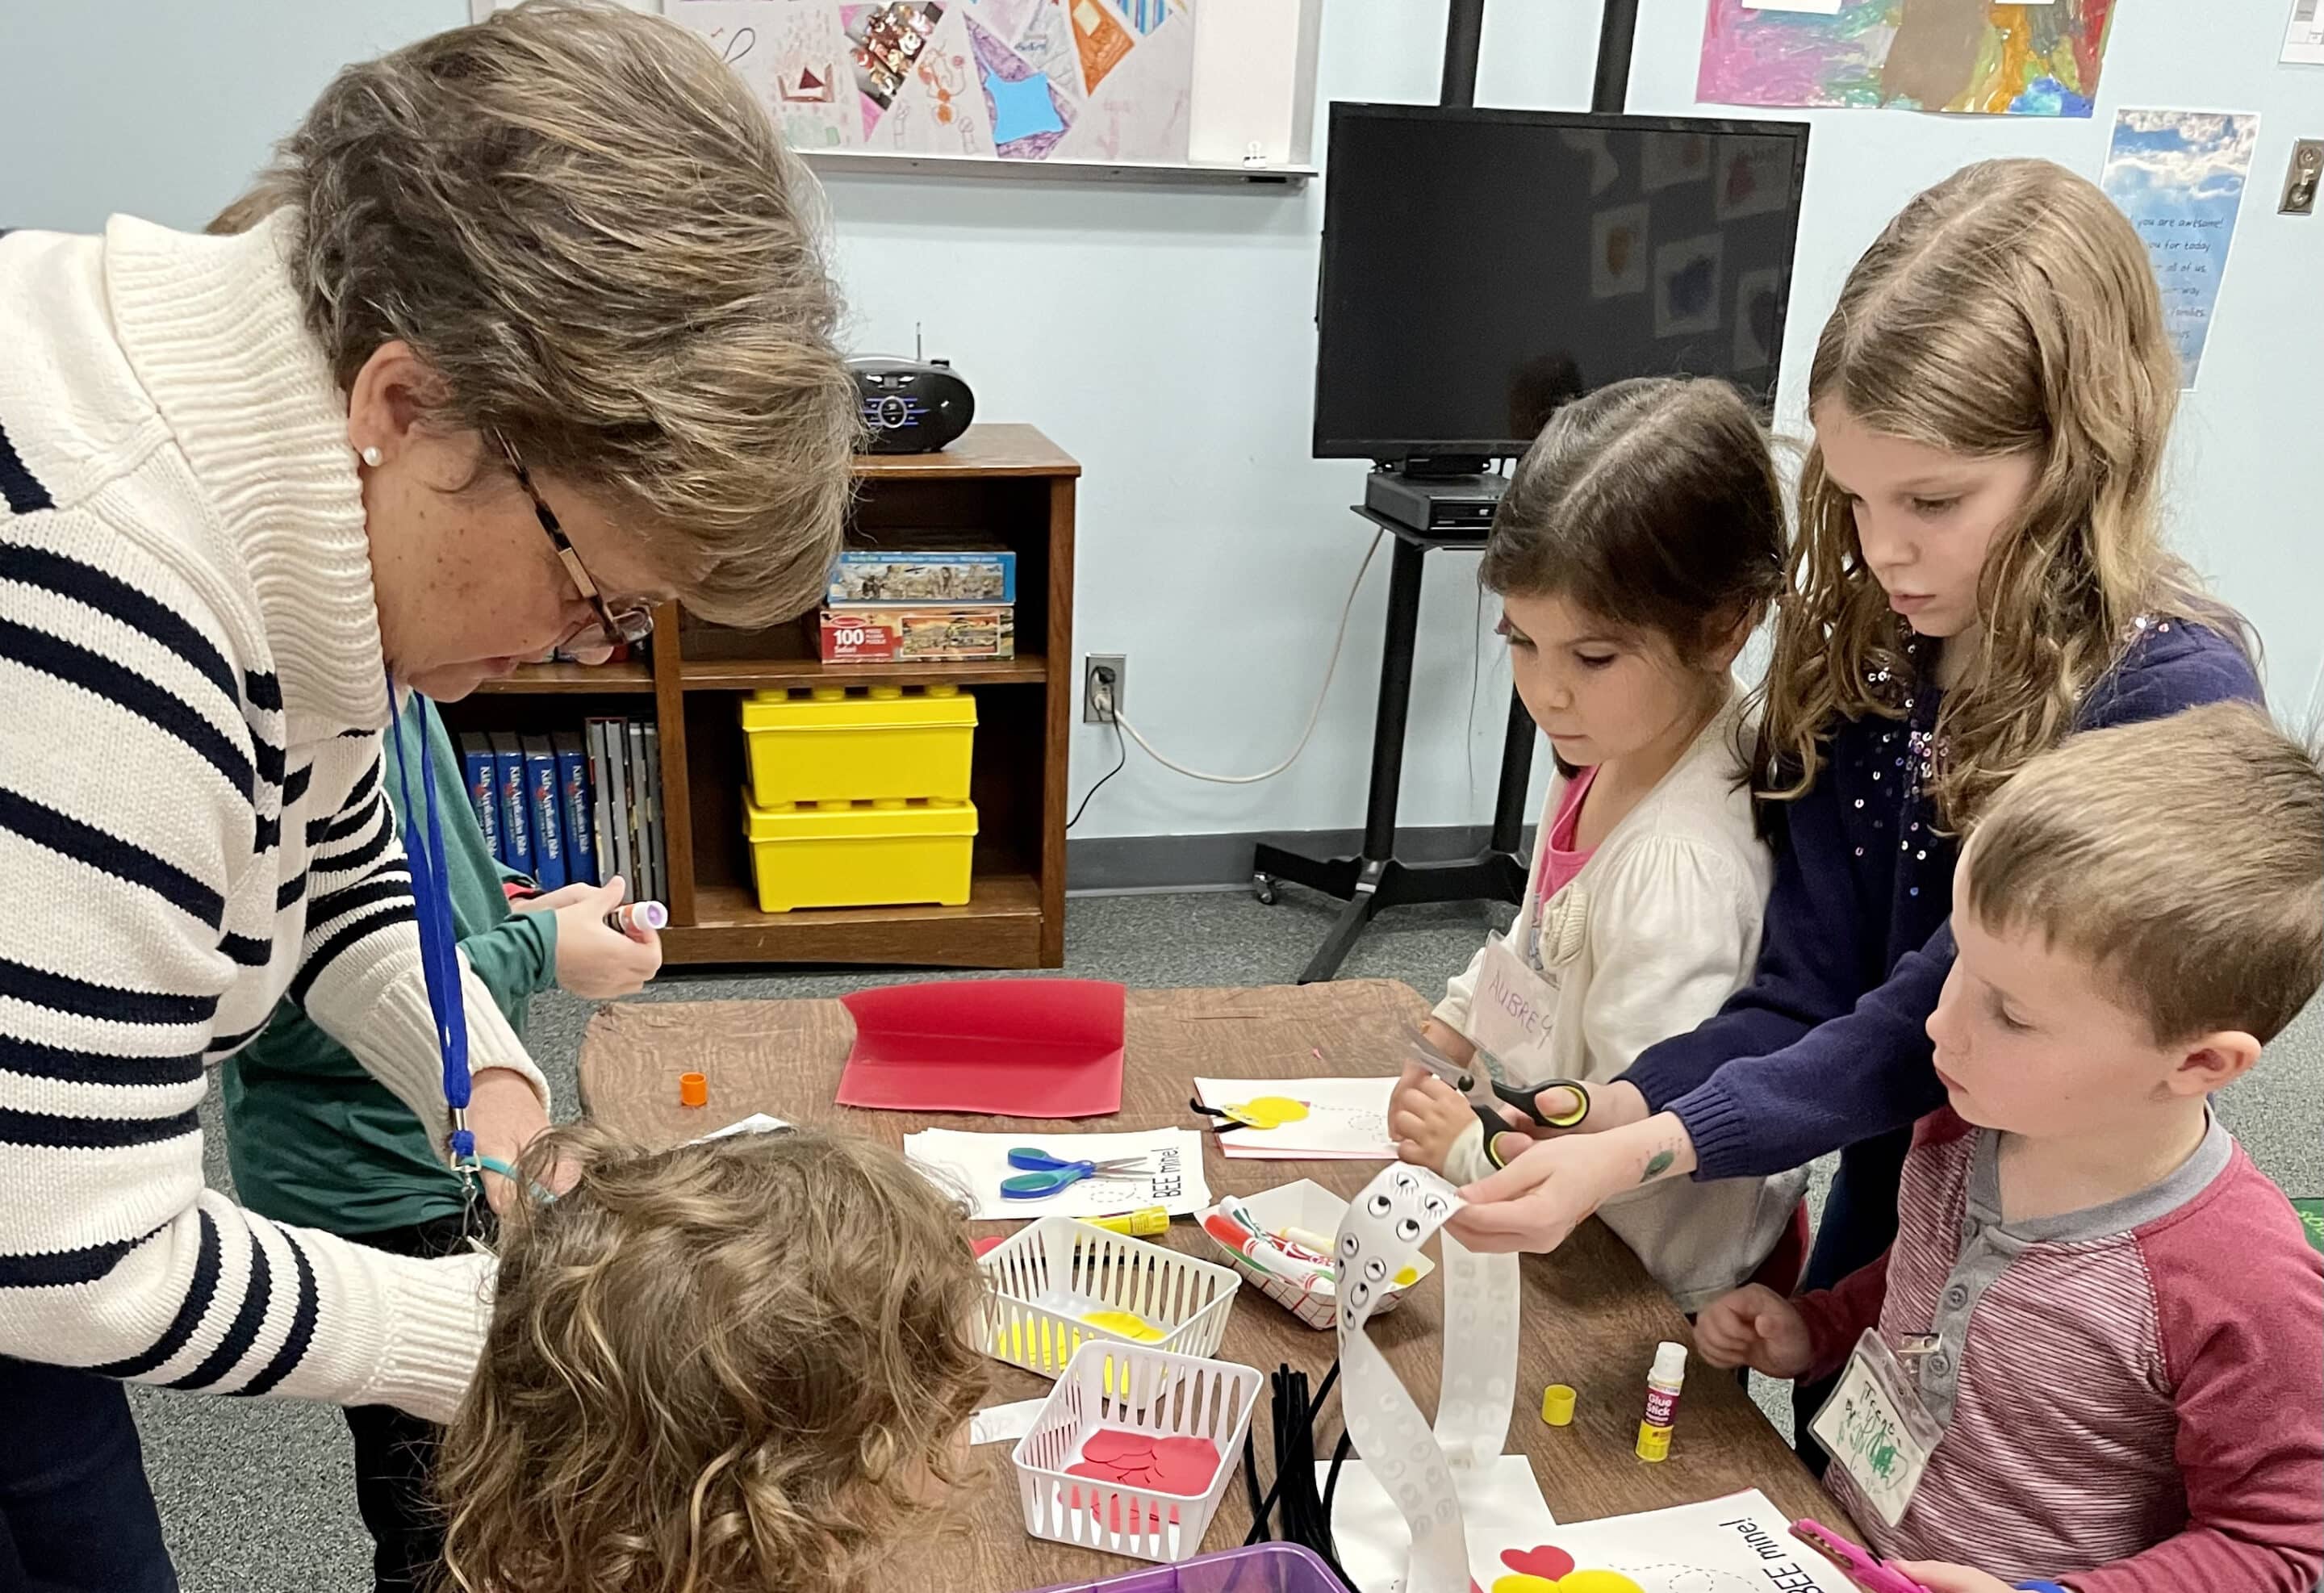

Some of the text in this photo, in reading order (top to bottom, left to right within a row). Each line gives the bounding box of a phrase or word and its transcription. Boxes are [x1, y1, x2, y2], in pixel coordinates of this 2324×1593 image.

[2157, 218, 2176, 228] are
[2165, 240, 2180, 250] for
[2184, 240, 2210, 253] today
[833, 629, 865, 646] 100
[1151, 1146, 1181, 1198] BEE mine!
[1649, 1393, 1673, 1407] Glue
[1646, 1402, 1671, 1416] Stick
[1719, 1517, 1787, 1560] mine!
